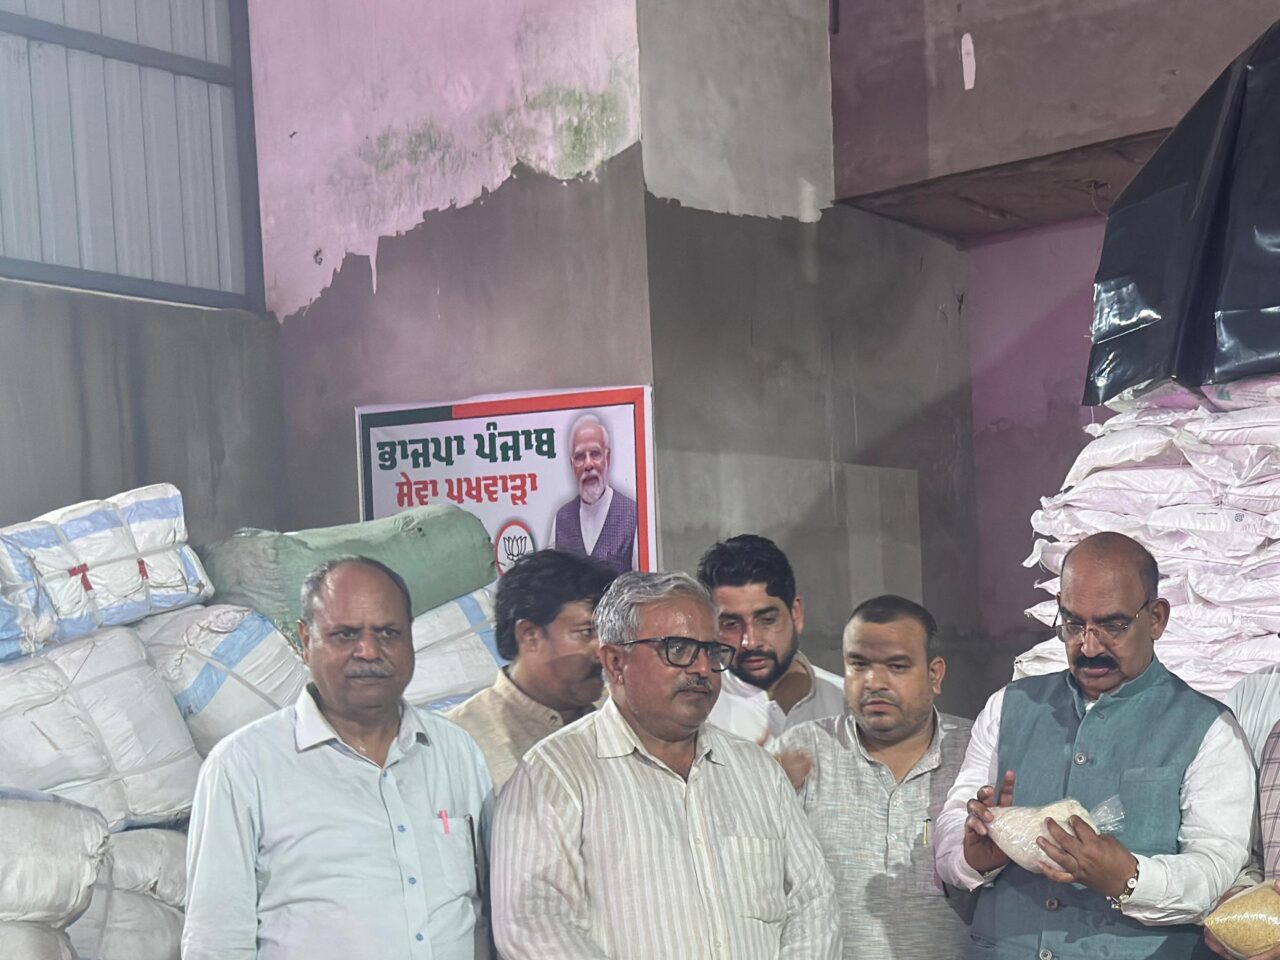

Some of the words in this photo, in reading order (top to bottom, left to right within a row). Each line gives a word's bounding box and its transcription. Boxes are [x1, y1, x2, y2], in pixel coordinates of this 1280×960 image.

[376, 434, 466, 471] ਭਾਜਪਾ
[473, 421, 557, 463] ਪੰਜਾਬ
[395, 471, 439, 508] ਸੇਵਾ
[445, 472, 539, 506] ਪਖਵਾੜਾ
